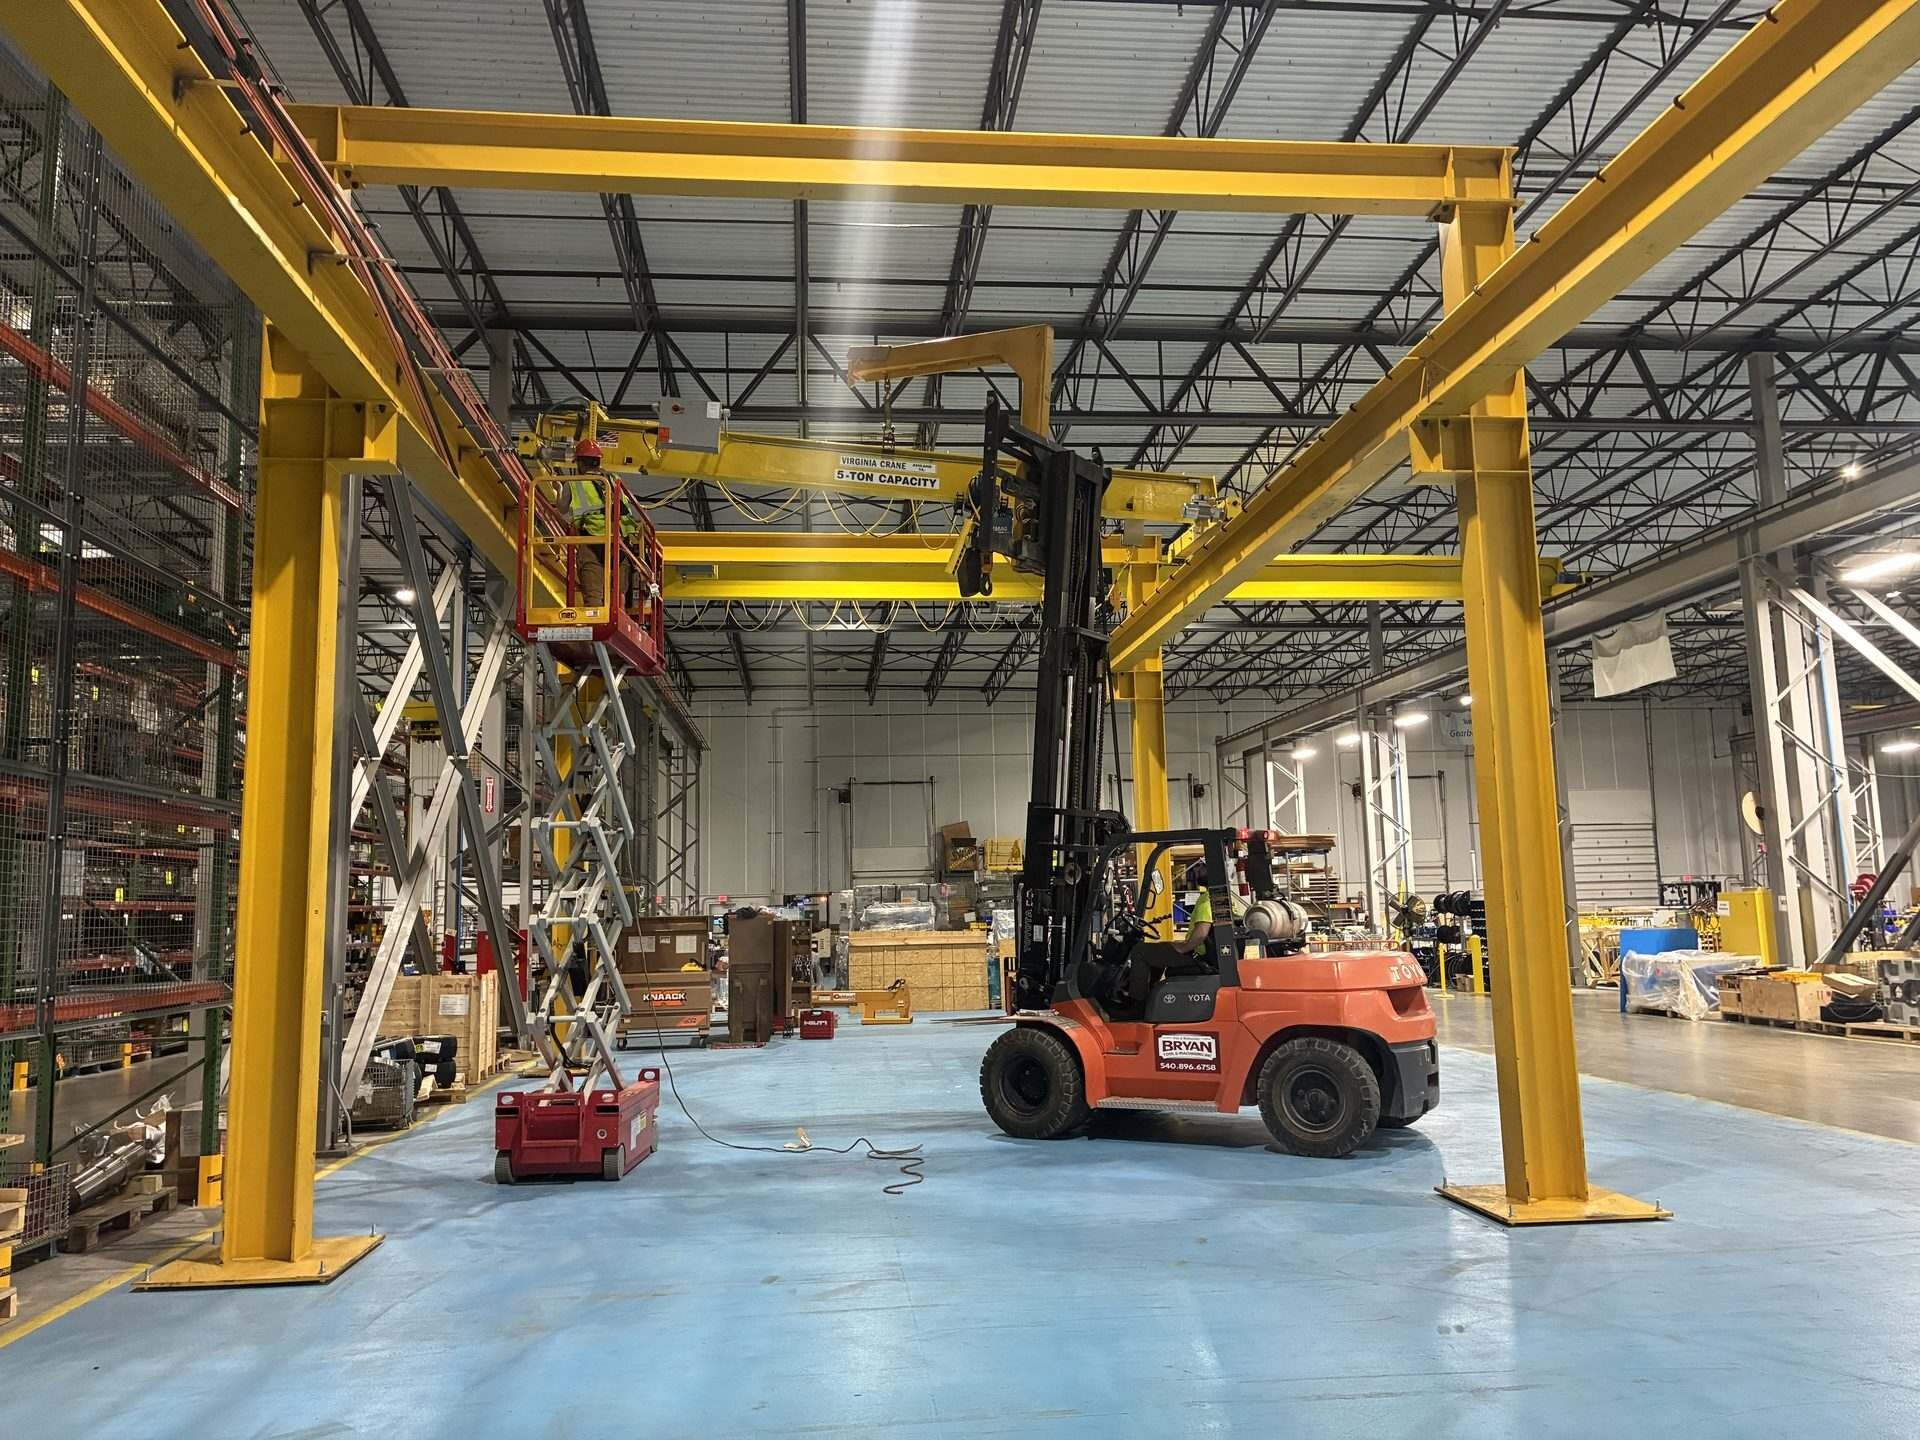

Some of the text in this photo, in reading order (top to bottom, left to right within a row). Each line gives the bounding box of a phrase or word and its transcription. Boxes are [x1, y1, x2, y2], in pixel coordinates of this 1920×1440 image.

[841, 456, 877, 467] VIRGINIA
[880, 460, 907, 470] CRANE
[836, 470, 937, 488] 5-TON CAPACITY
[642, 993, 686, 1001] KNAACK
[1188, 994, 1210, 1002] YOTA
[1162, 1040, 1213, 1053] BRYAN
[1160, 1062, 1217, 1071] 540.896.6758
